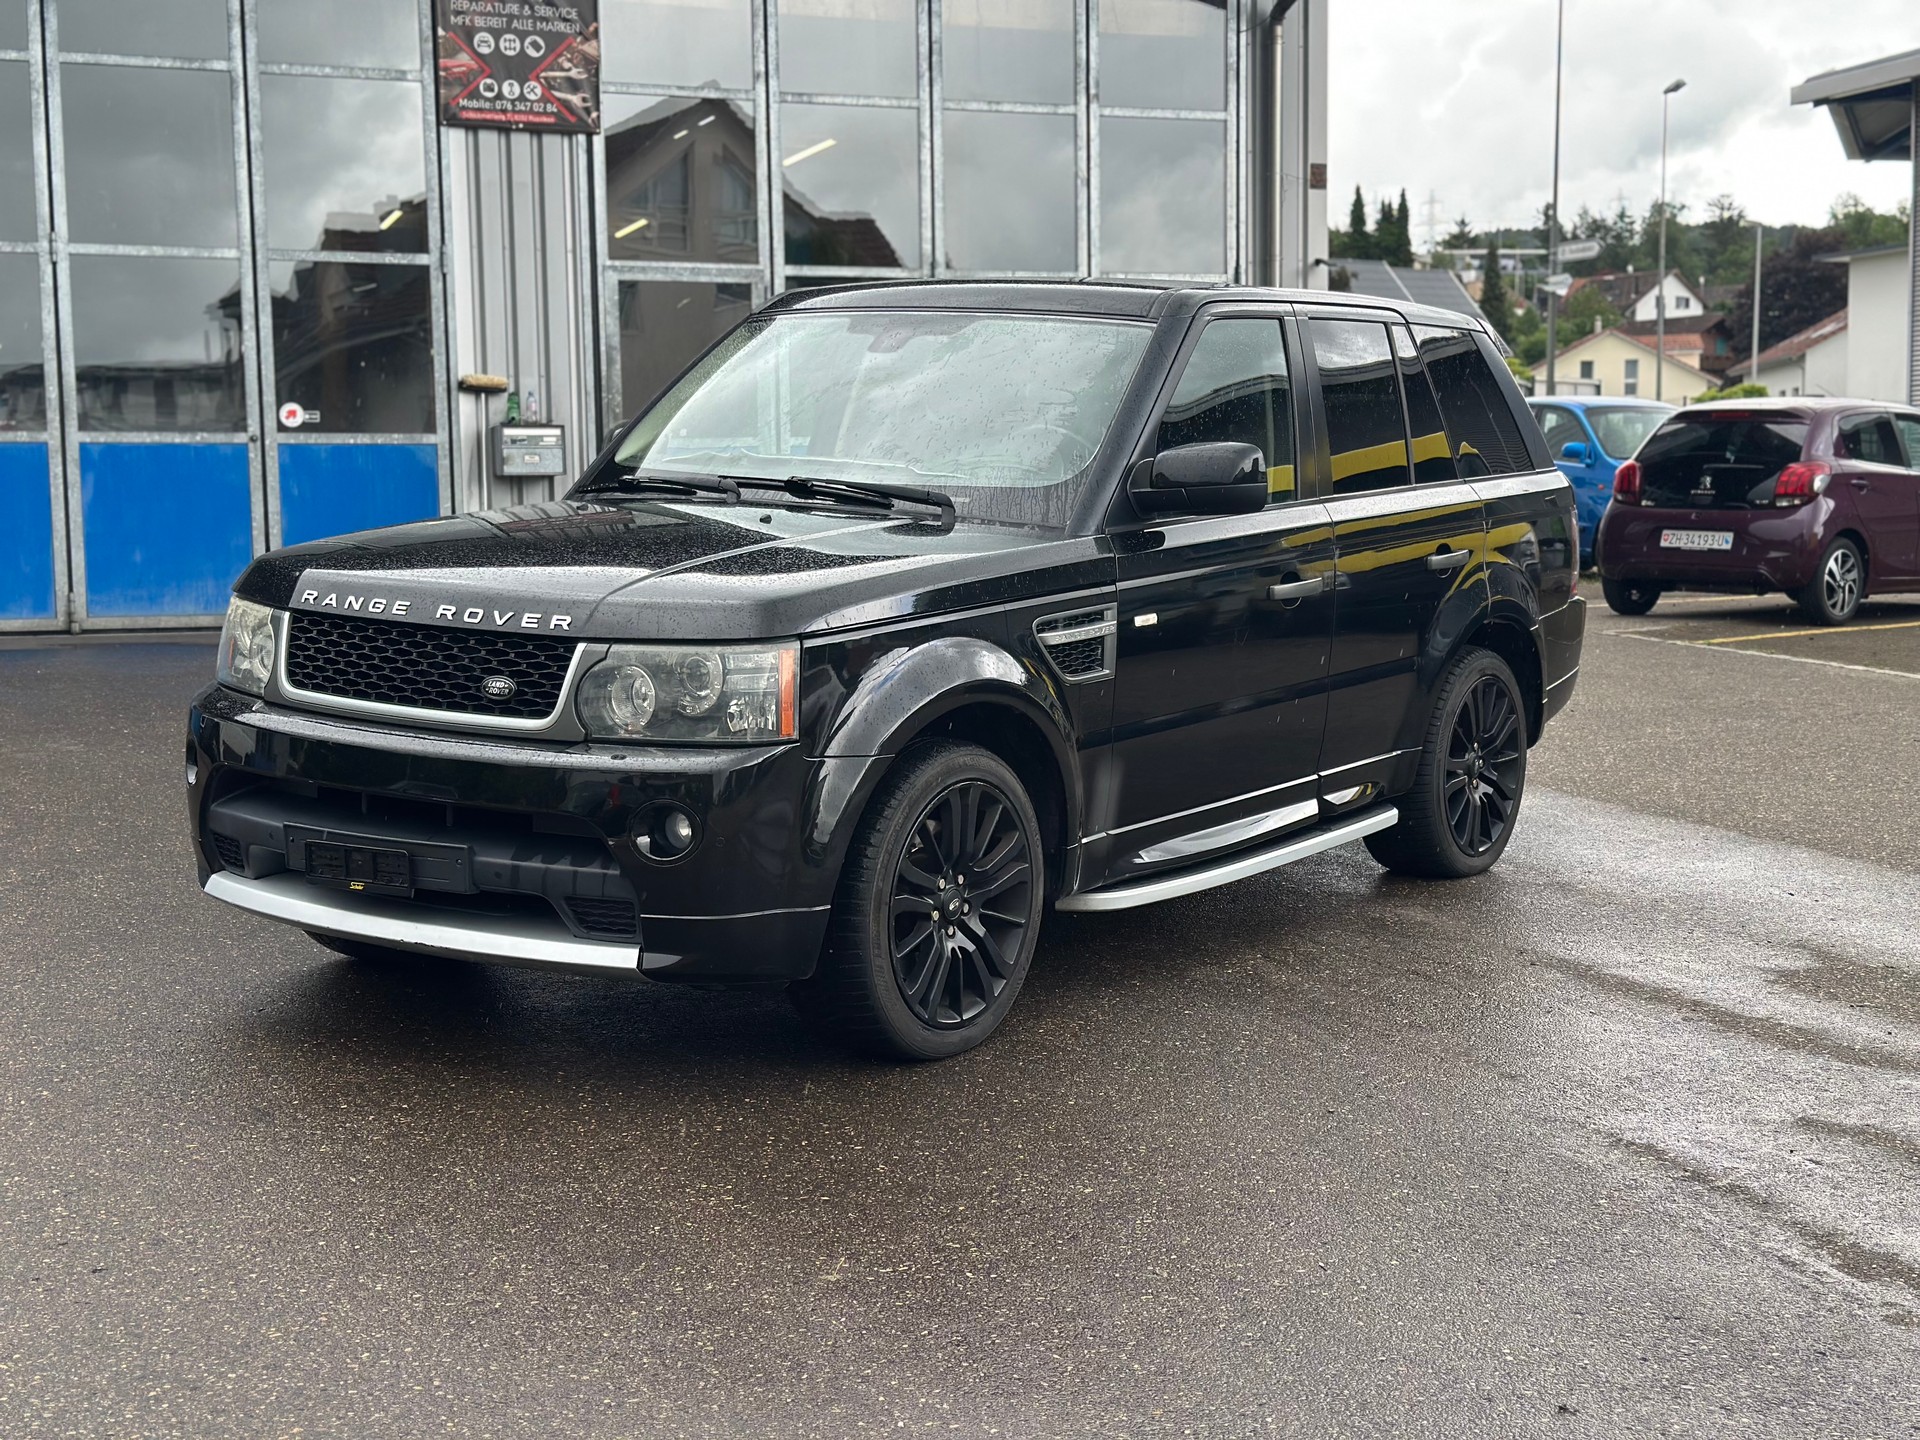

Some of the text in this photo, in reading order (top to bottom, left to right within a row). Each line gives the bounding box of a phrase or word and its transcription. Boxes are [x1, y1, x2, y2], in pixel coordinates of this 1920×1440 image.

[450, 0, 578, 19] REPARATURE & SERVICE
[450, 14, 580, 33] MFK BEREIT ALLE MARKEN
[459, 98, 558, 112] Mobile: 076 347 02 84
[301, 589, 573, 631] RANGE ROVER
[488, 687, 510, 695] ROVER
